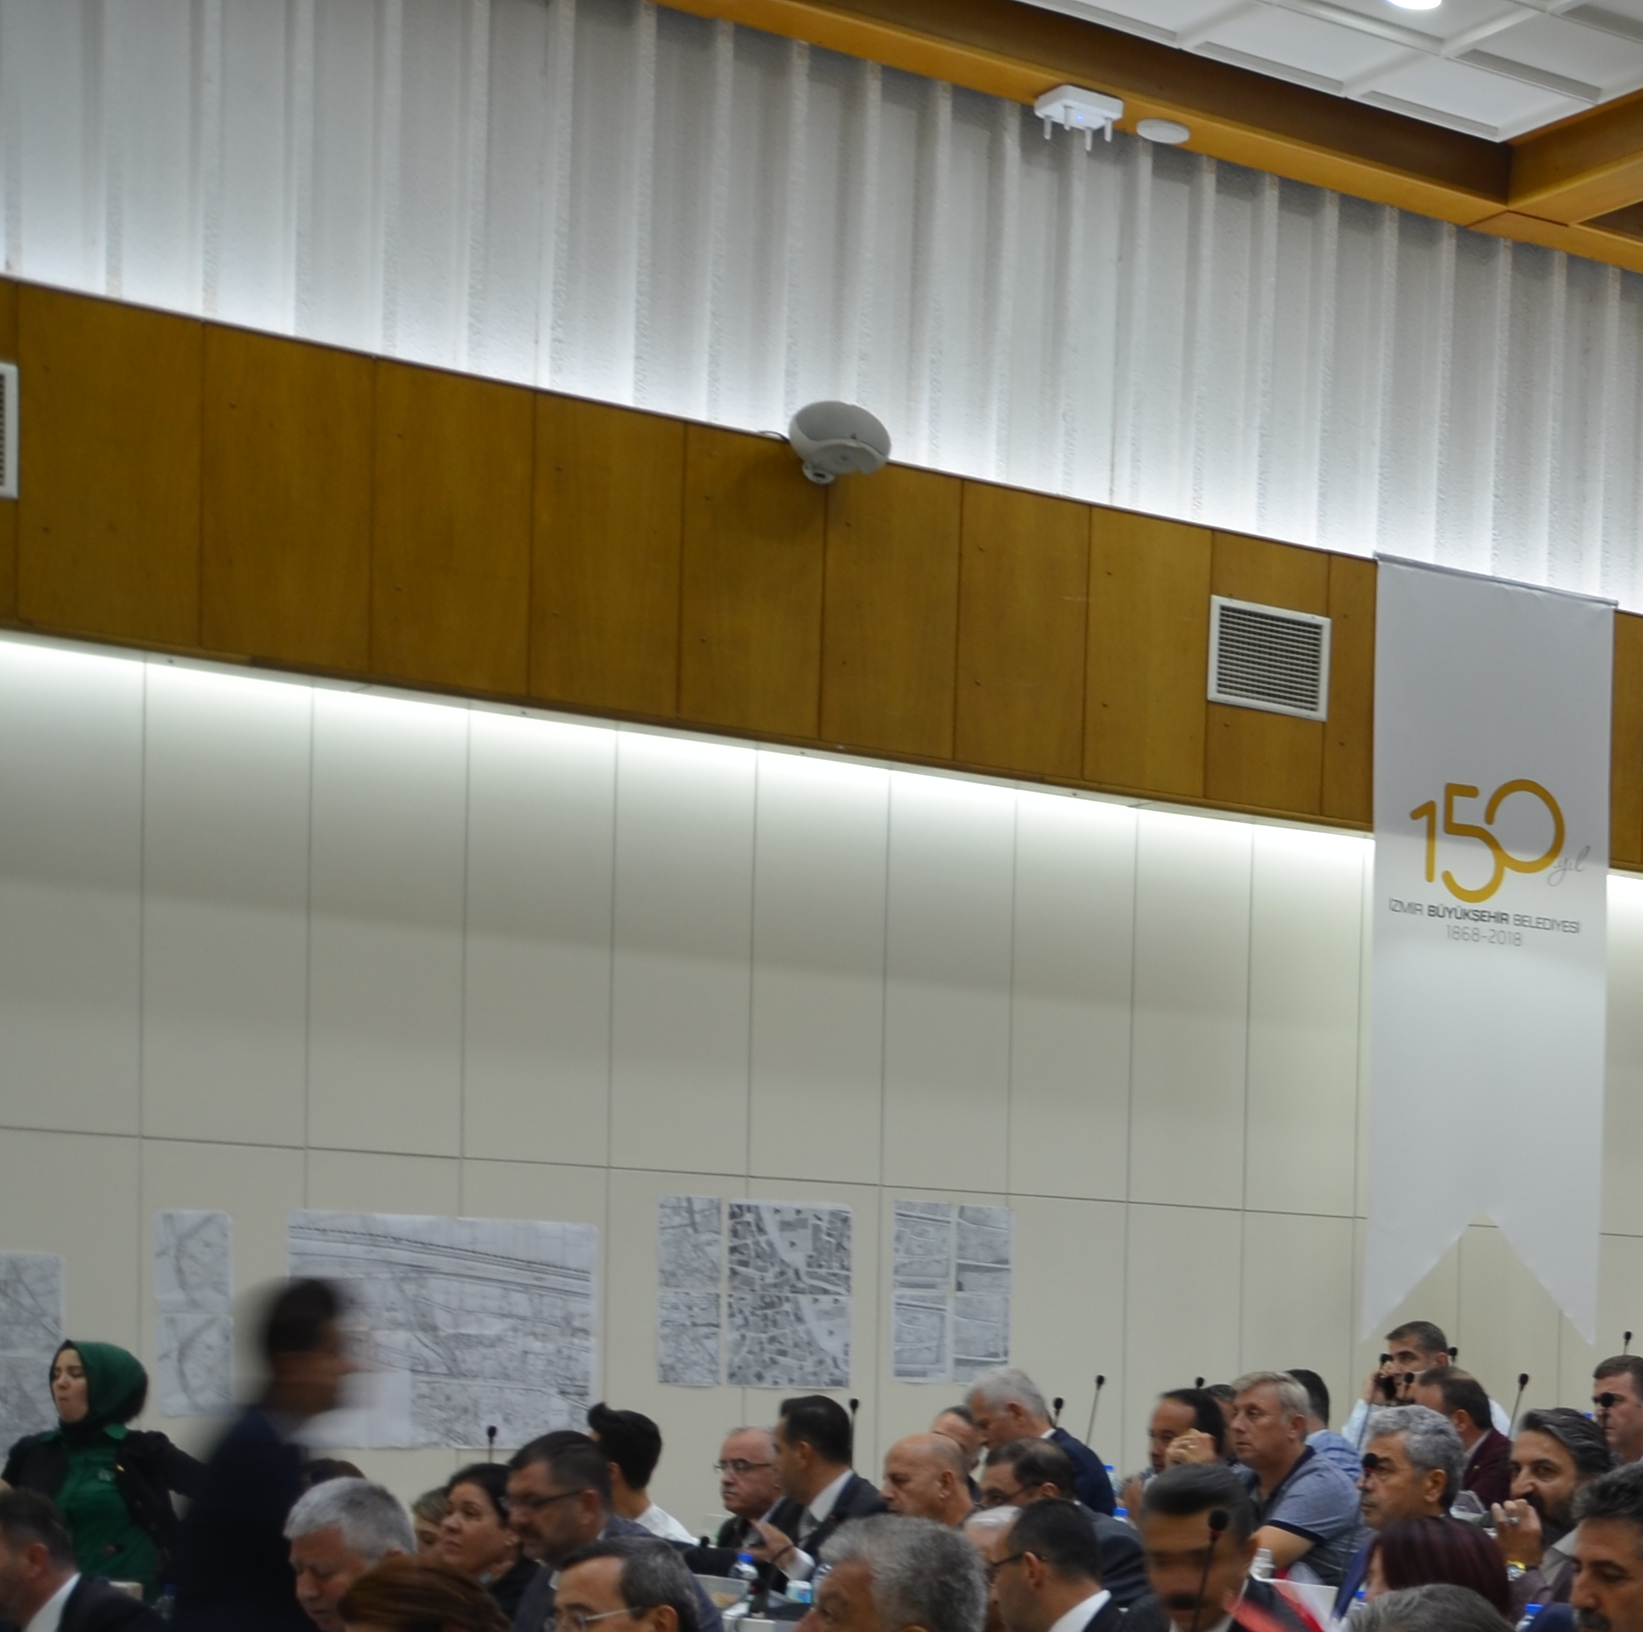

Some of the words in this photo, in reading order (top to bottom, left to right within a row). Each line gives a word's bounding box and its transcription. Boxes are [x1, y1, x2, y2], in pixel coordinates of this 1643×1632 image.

[1409, 778, 1566, 904] 150
[1427, 903, 1510, 925] BÜYÜKŞEHİR
[1446, 924, 1523, 947] 1868-2018
